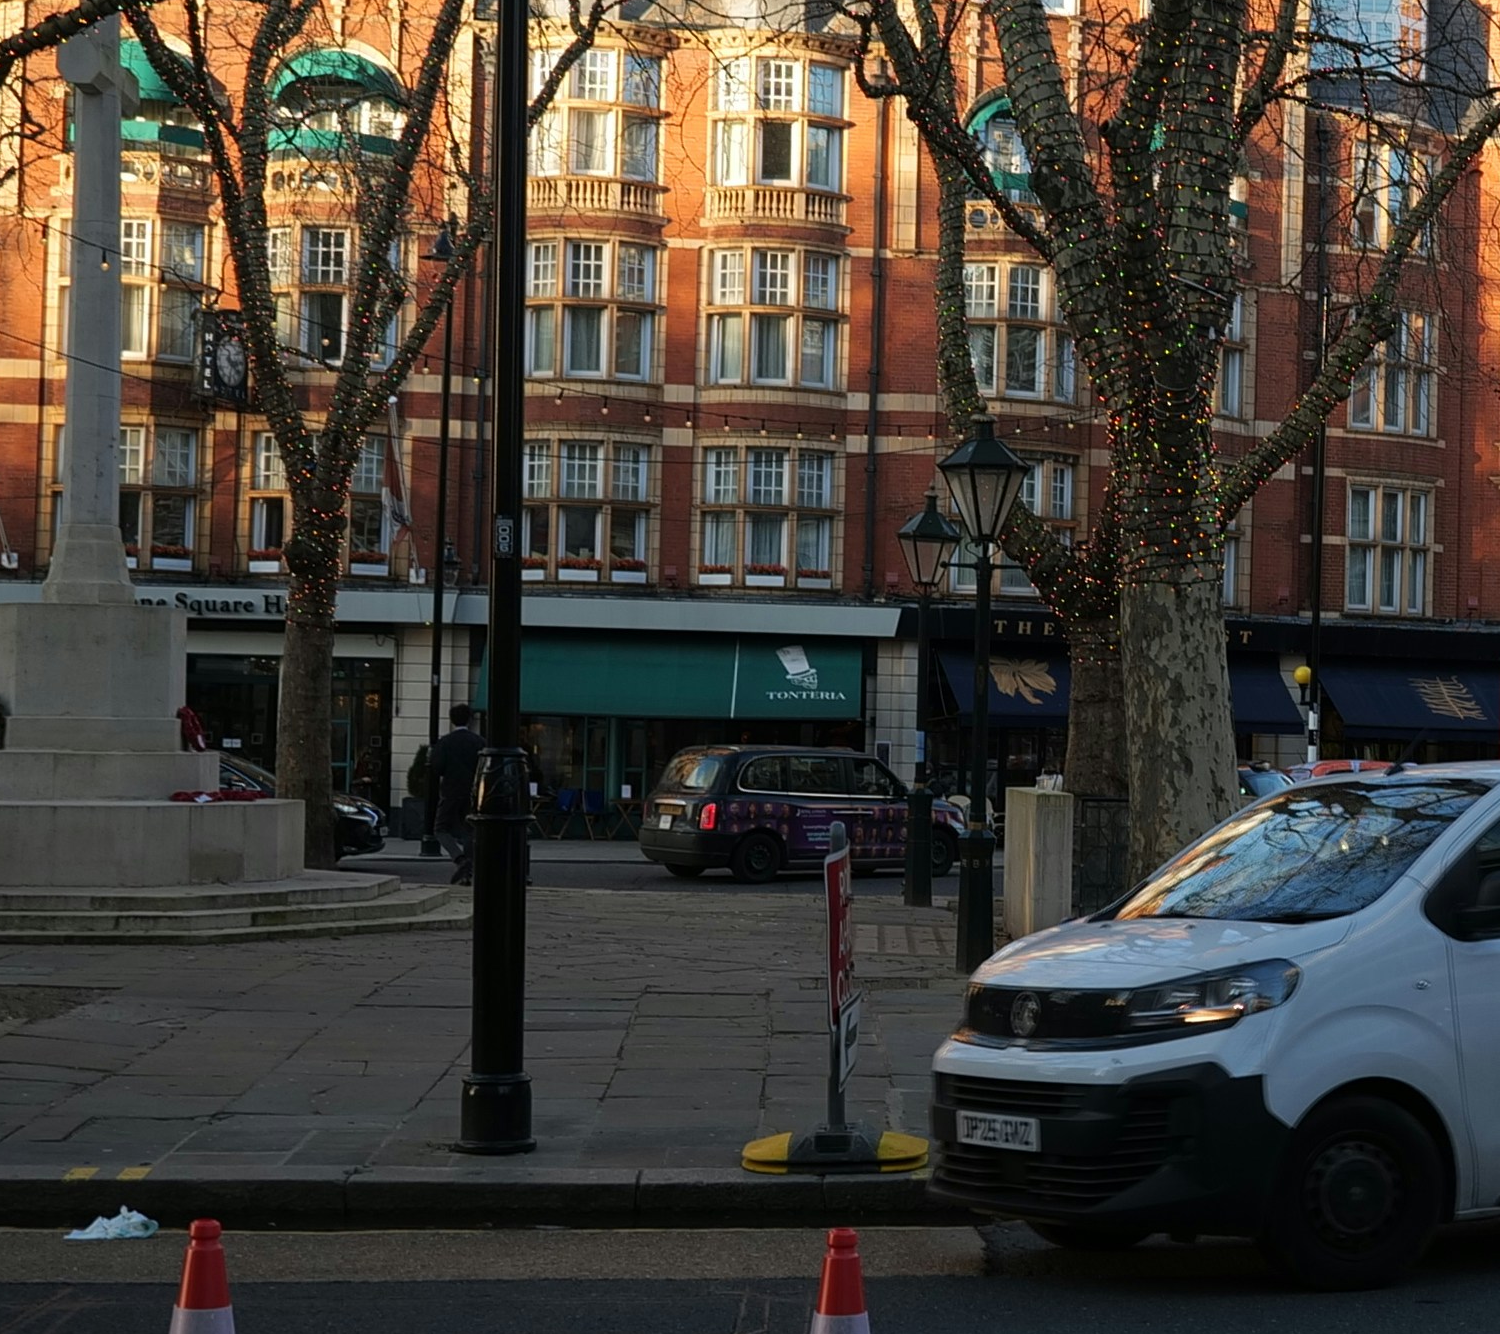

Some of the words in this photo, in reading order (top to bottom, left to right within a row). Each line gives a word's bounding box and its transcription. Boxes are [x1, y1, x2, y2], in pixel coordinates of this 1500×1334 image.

[175, 593, 254, 615] Square
[993, 620, 1055, 636] THE
[766, 690, 847, 701] TONTERIA
